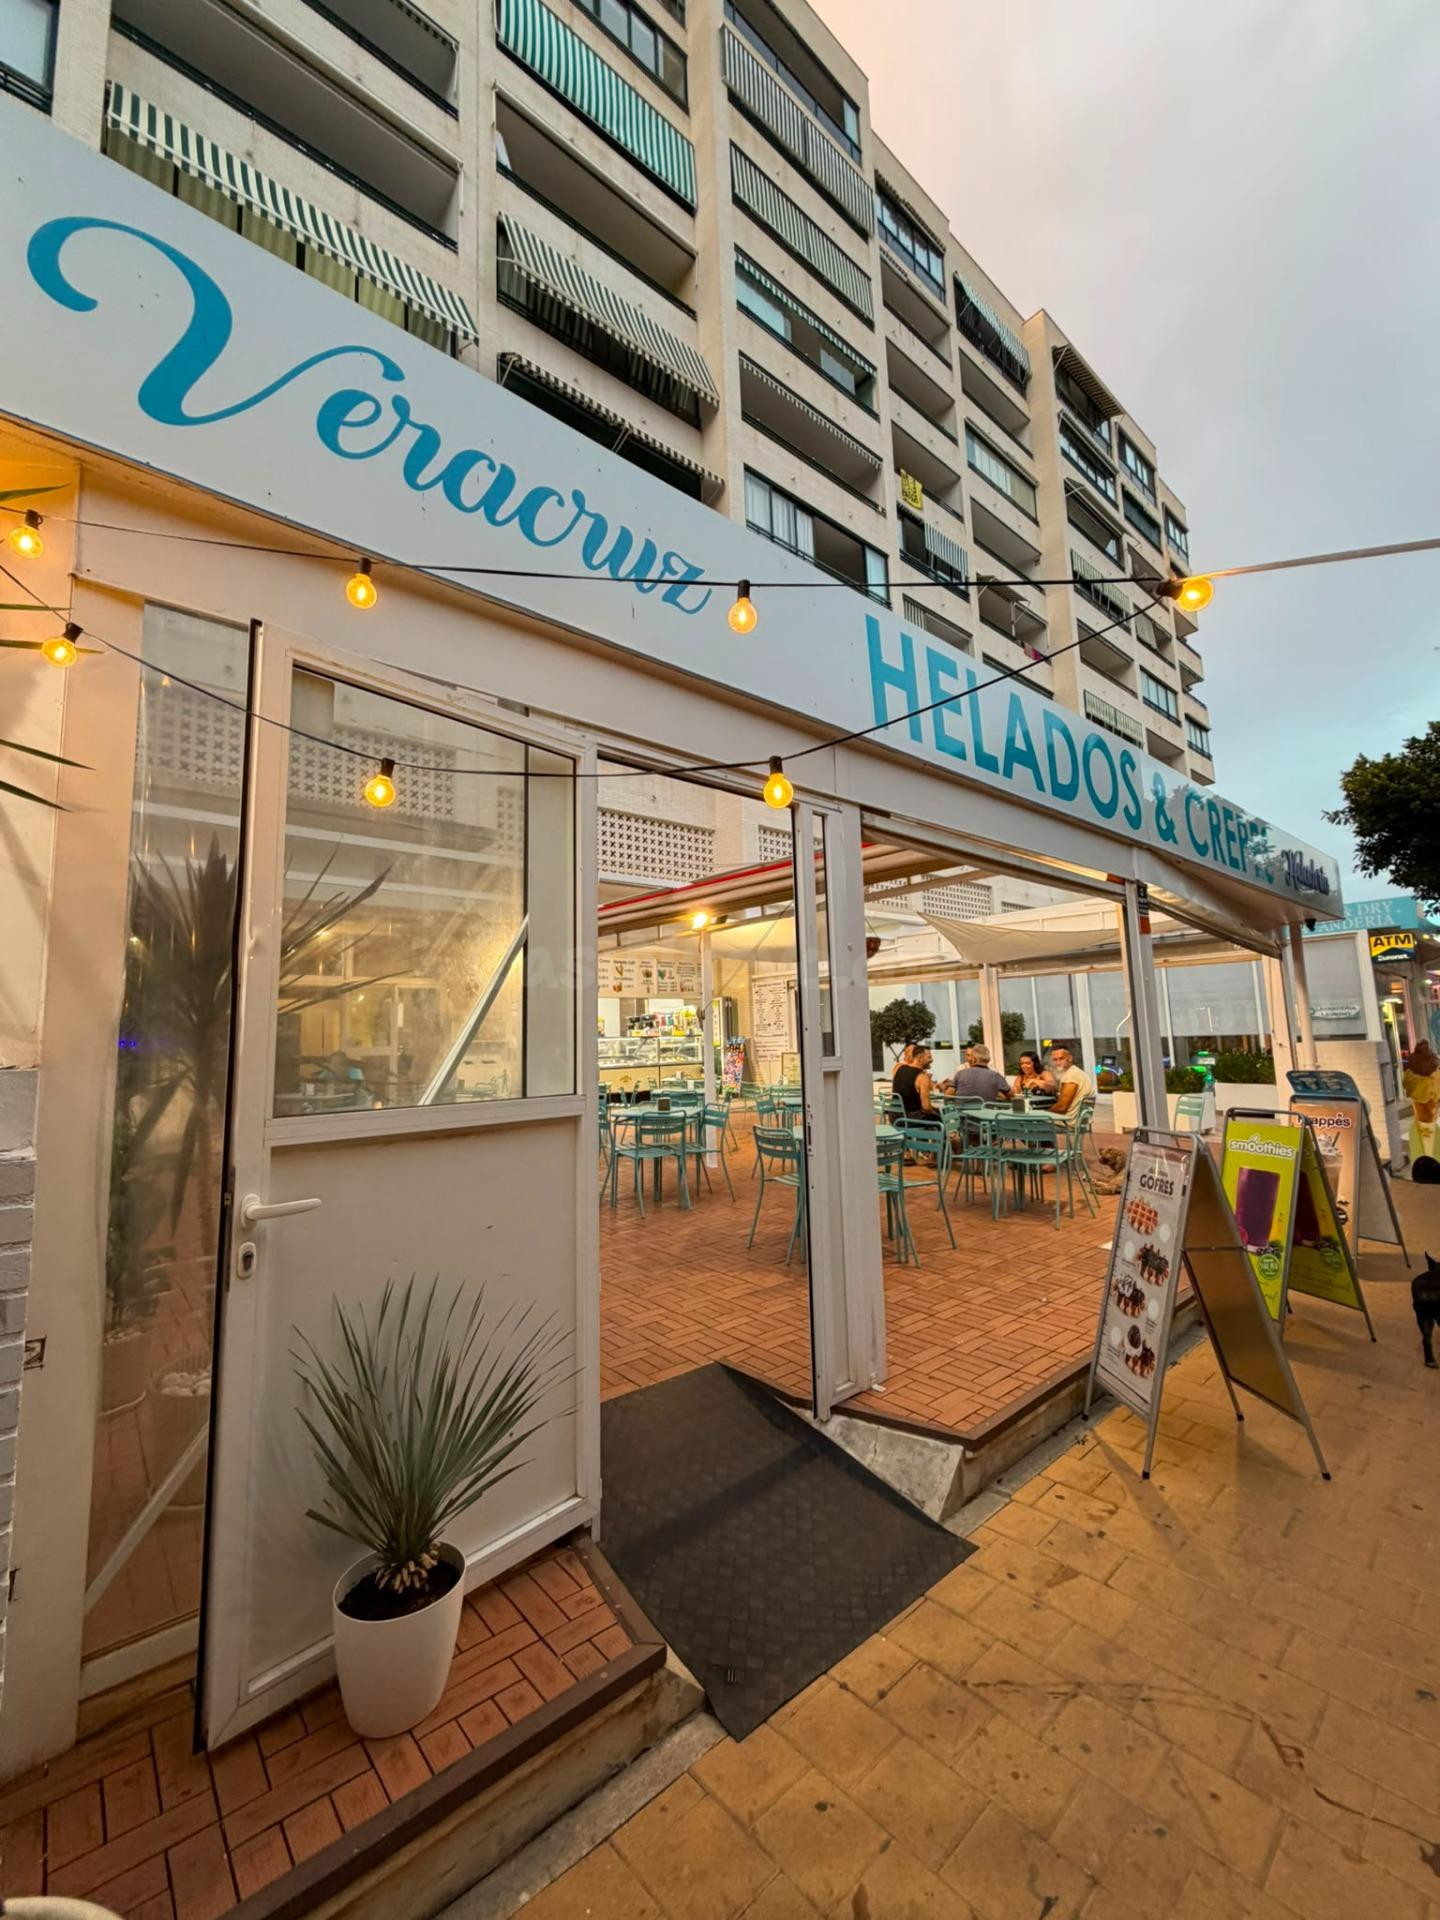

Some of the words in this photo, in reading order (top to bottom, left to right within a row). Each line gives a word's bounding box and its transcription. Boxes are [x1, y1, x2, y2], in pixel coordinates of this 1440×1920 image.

[26, 215, 713, 615] Veracruz
[865, 613, 1143, 832] HELADOS
[1153, 771, 1179, 846] &
[1357, 900, 1393, 916] DRY
[1373, 934, 1412, 947] ATM
[1229, 1138, 1296, 1160] smoothies
[1139, 1173, 1175, 1197] GOFRES
